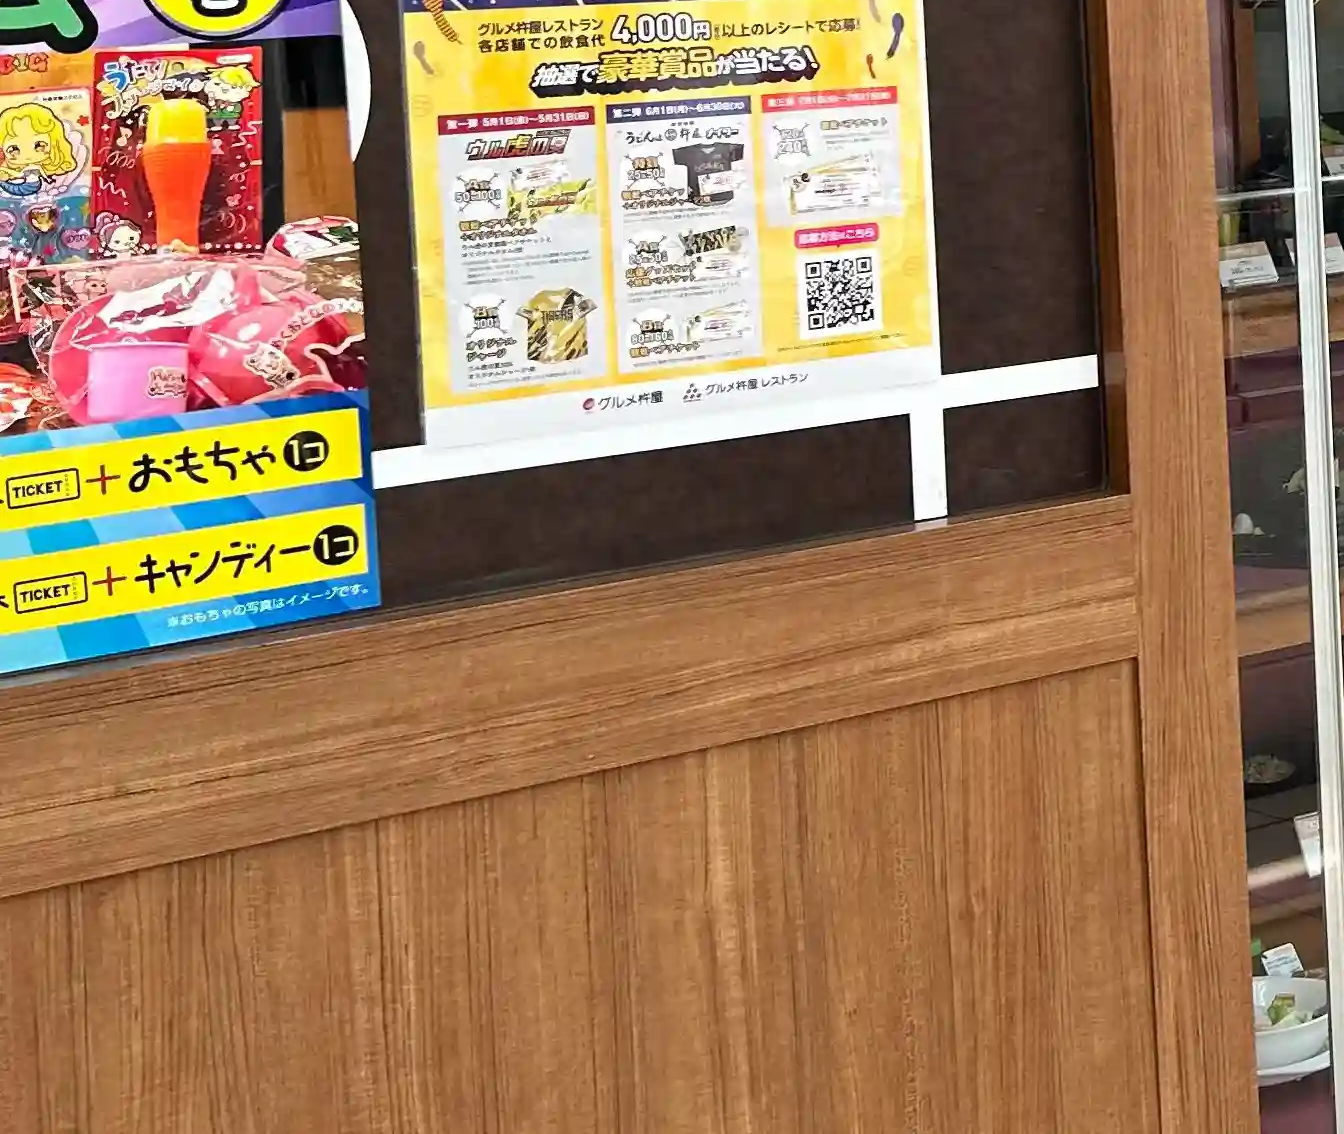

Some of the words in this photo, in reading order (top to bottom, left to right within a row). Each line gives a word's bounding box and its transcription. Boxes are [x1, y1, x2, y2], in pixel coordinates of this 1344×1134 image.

[478, 19, 604, 37] グルメ杵屋レストラン
[610, 12, 713, 44] 4,000円
[478, 35, 606, 54] 各店舗での飲食代
[532, 45, 820, 90] 抽選で豪華賞品が当たる!
[597, 390, 664, 411] グルメ杵屋
[128, 440, 277, 494] おもちゃ
[12, 479, 64, 500] TICKET
[134, 541, 312, 595] キャンディー
[19, 582, 71, 604] TICKET
